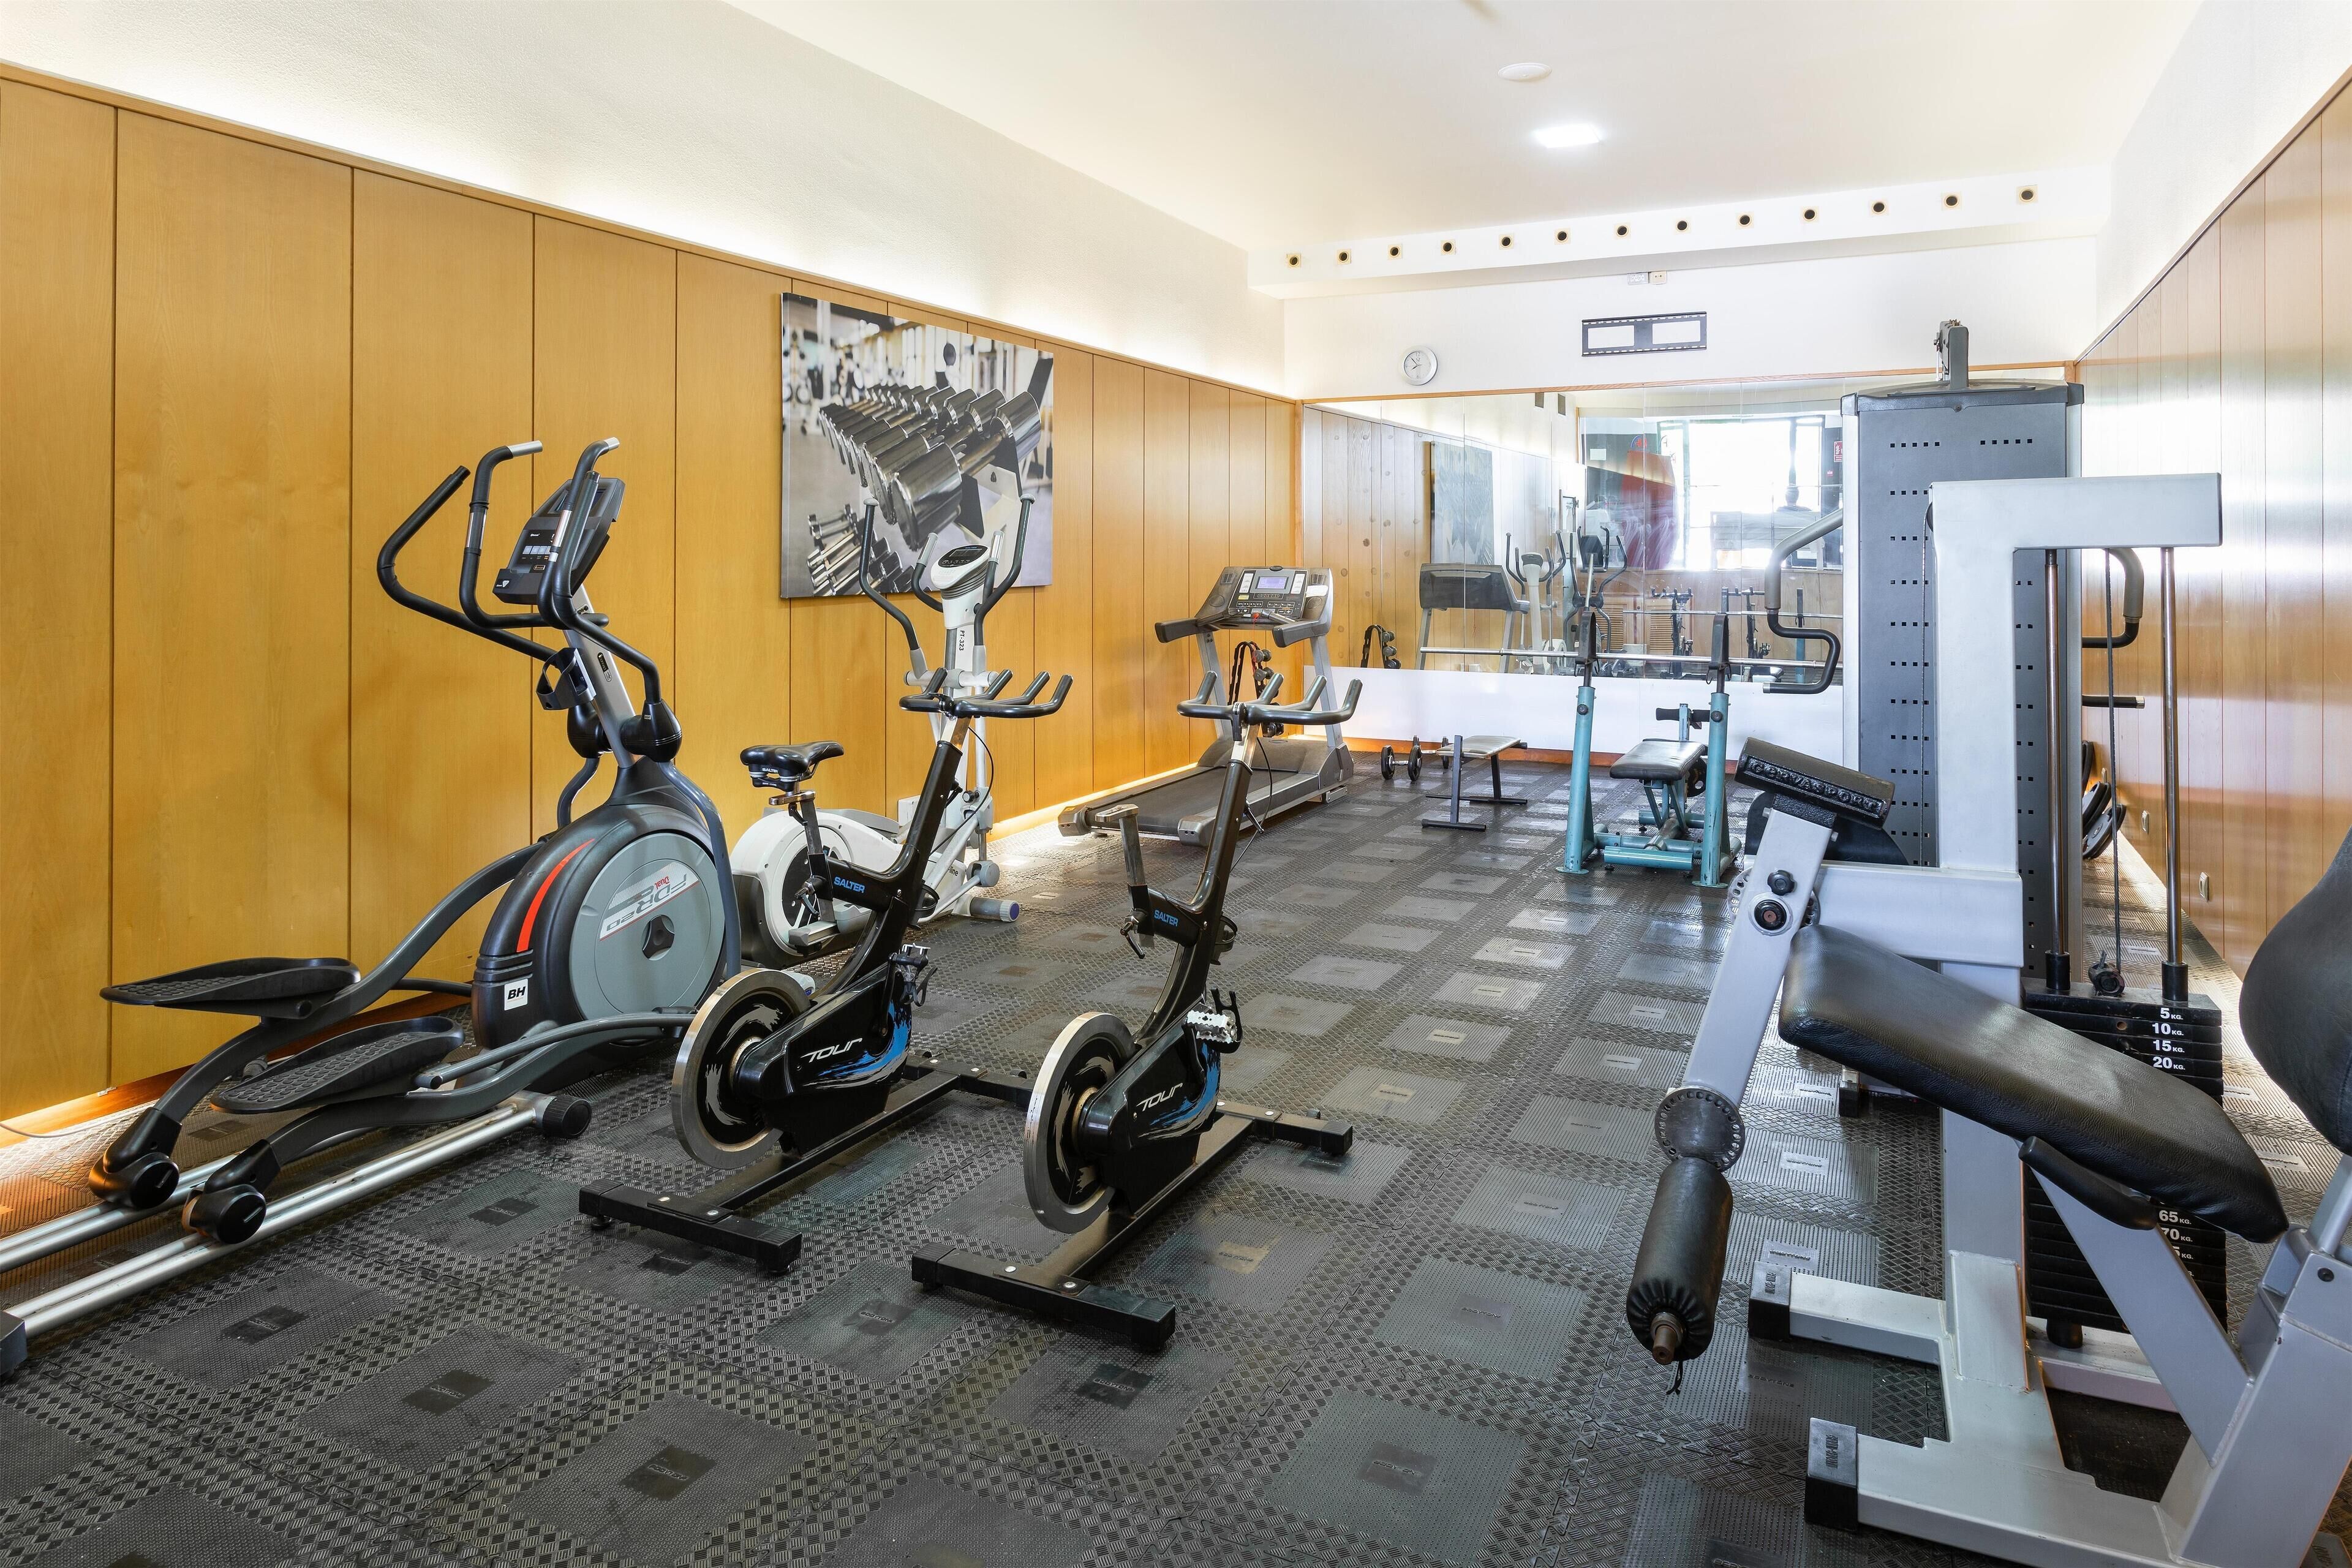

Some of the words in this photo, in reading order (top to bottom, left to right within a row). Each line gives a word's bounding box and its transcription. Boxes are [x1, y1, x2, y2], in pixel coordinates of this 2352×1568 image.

[654, 876, 671, 889] Dual
[834, 876, 865, 894] SALTER
[1154, 910, 1178, 927] SALTER
[507, 986, 526, 1000] BH
[2160, 1007, 2170, 1019] 5
[2152, 1022, 2171, 1035] 10
[2153, 1039, 2171, 1052] 15
[2152, 1056, 2173, 1069] 20
[2158, 1210, 2179, 1223] 65
